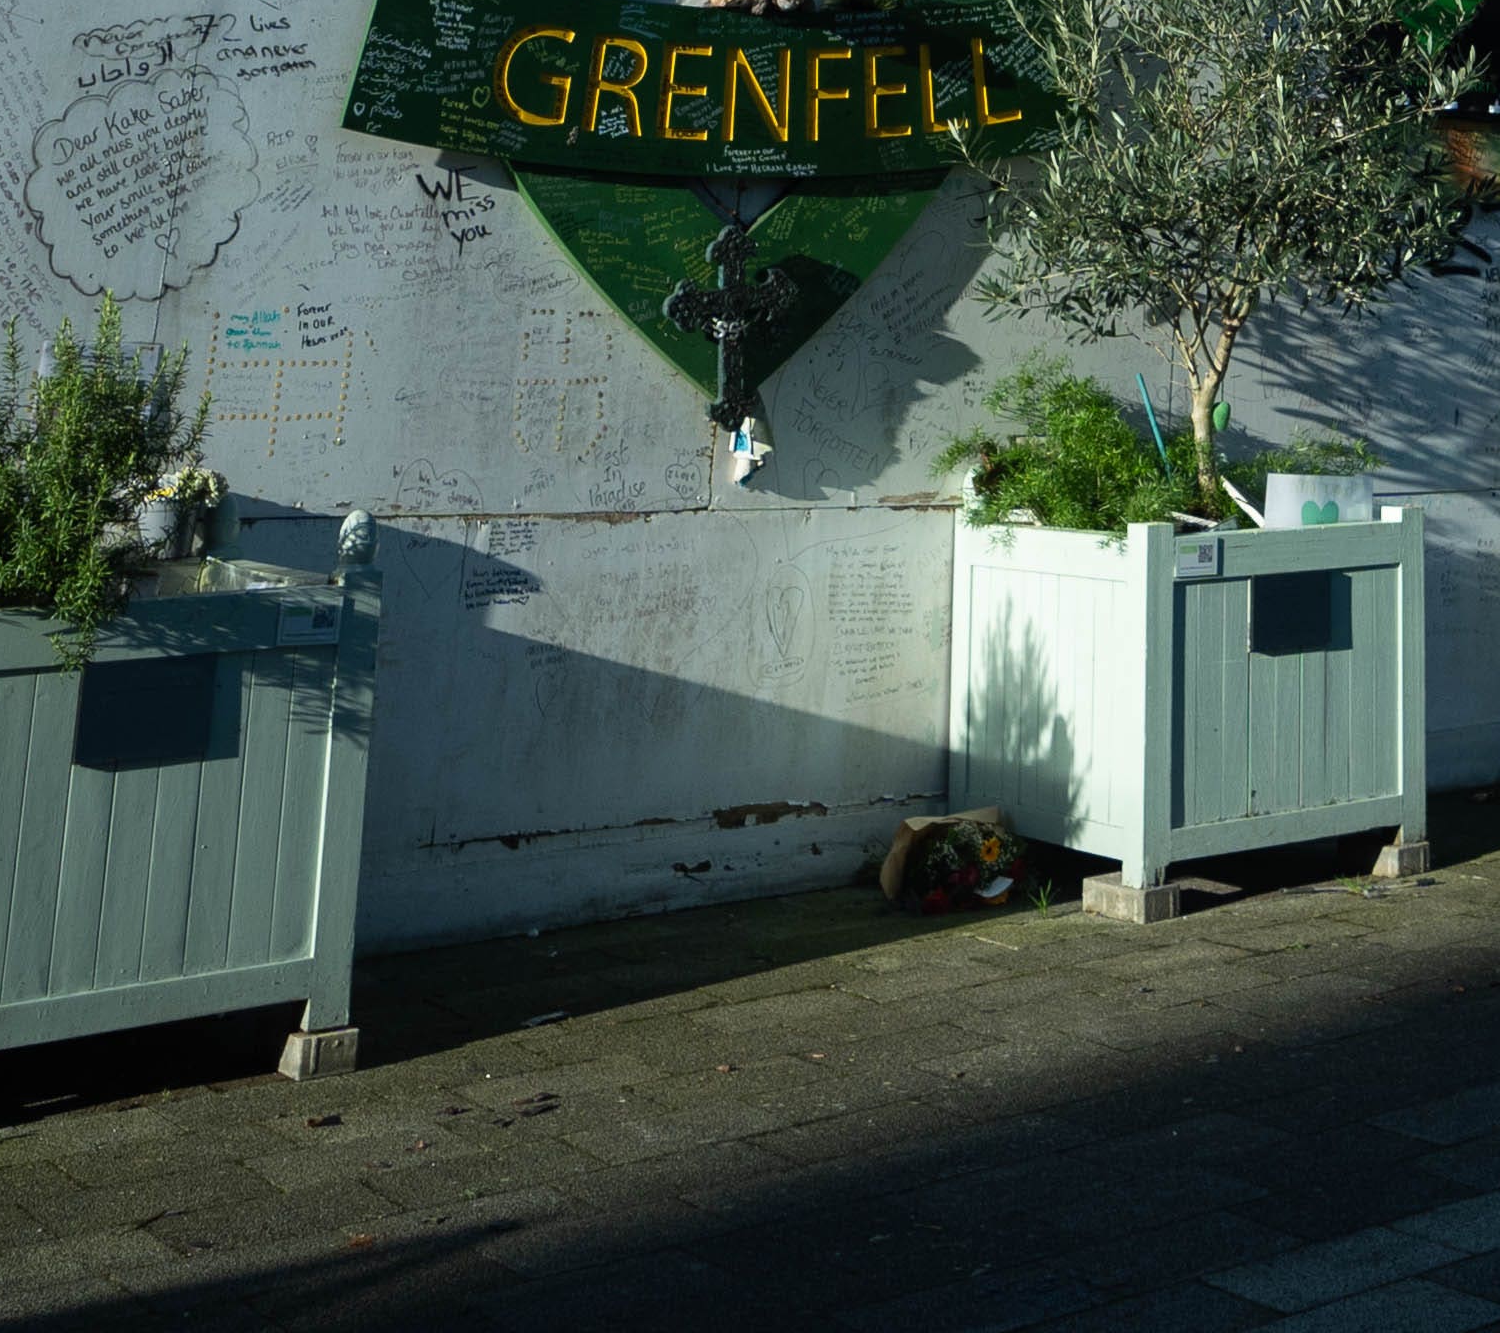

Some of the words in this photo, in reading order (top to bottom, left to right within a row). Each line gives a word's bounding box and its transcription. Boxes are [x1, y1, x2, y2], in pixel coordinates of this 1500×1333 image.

[494, 25, 1022, 143] GRENFELL
[52, 127, 98, 165] Dear
[80, 152, 101, 173] all
[103, 140, 134, 158] miss
[66, 181, 92, 200] and
[98, 177, 127, 200] have
[416, 165, 480, 203] WE
[442, 195, 496, 228] miss
[451, 223, 492, 256] you
